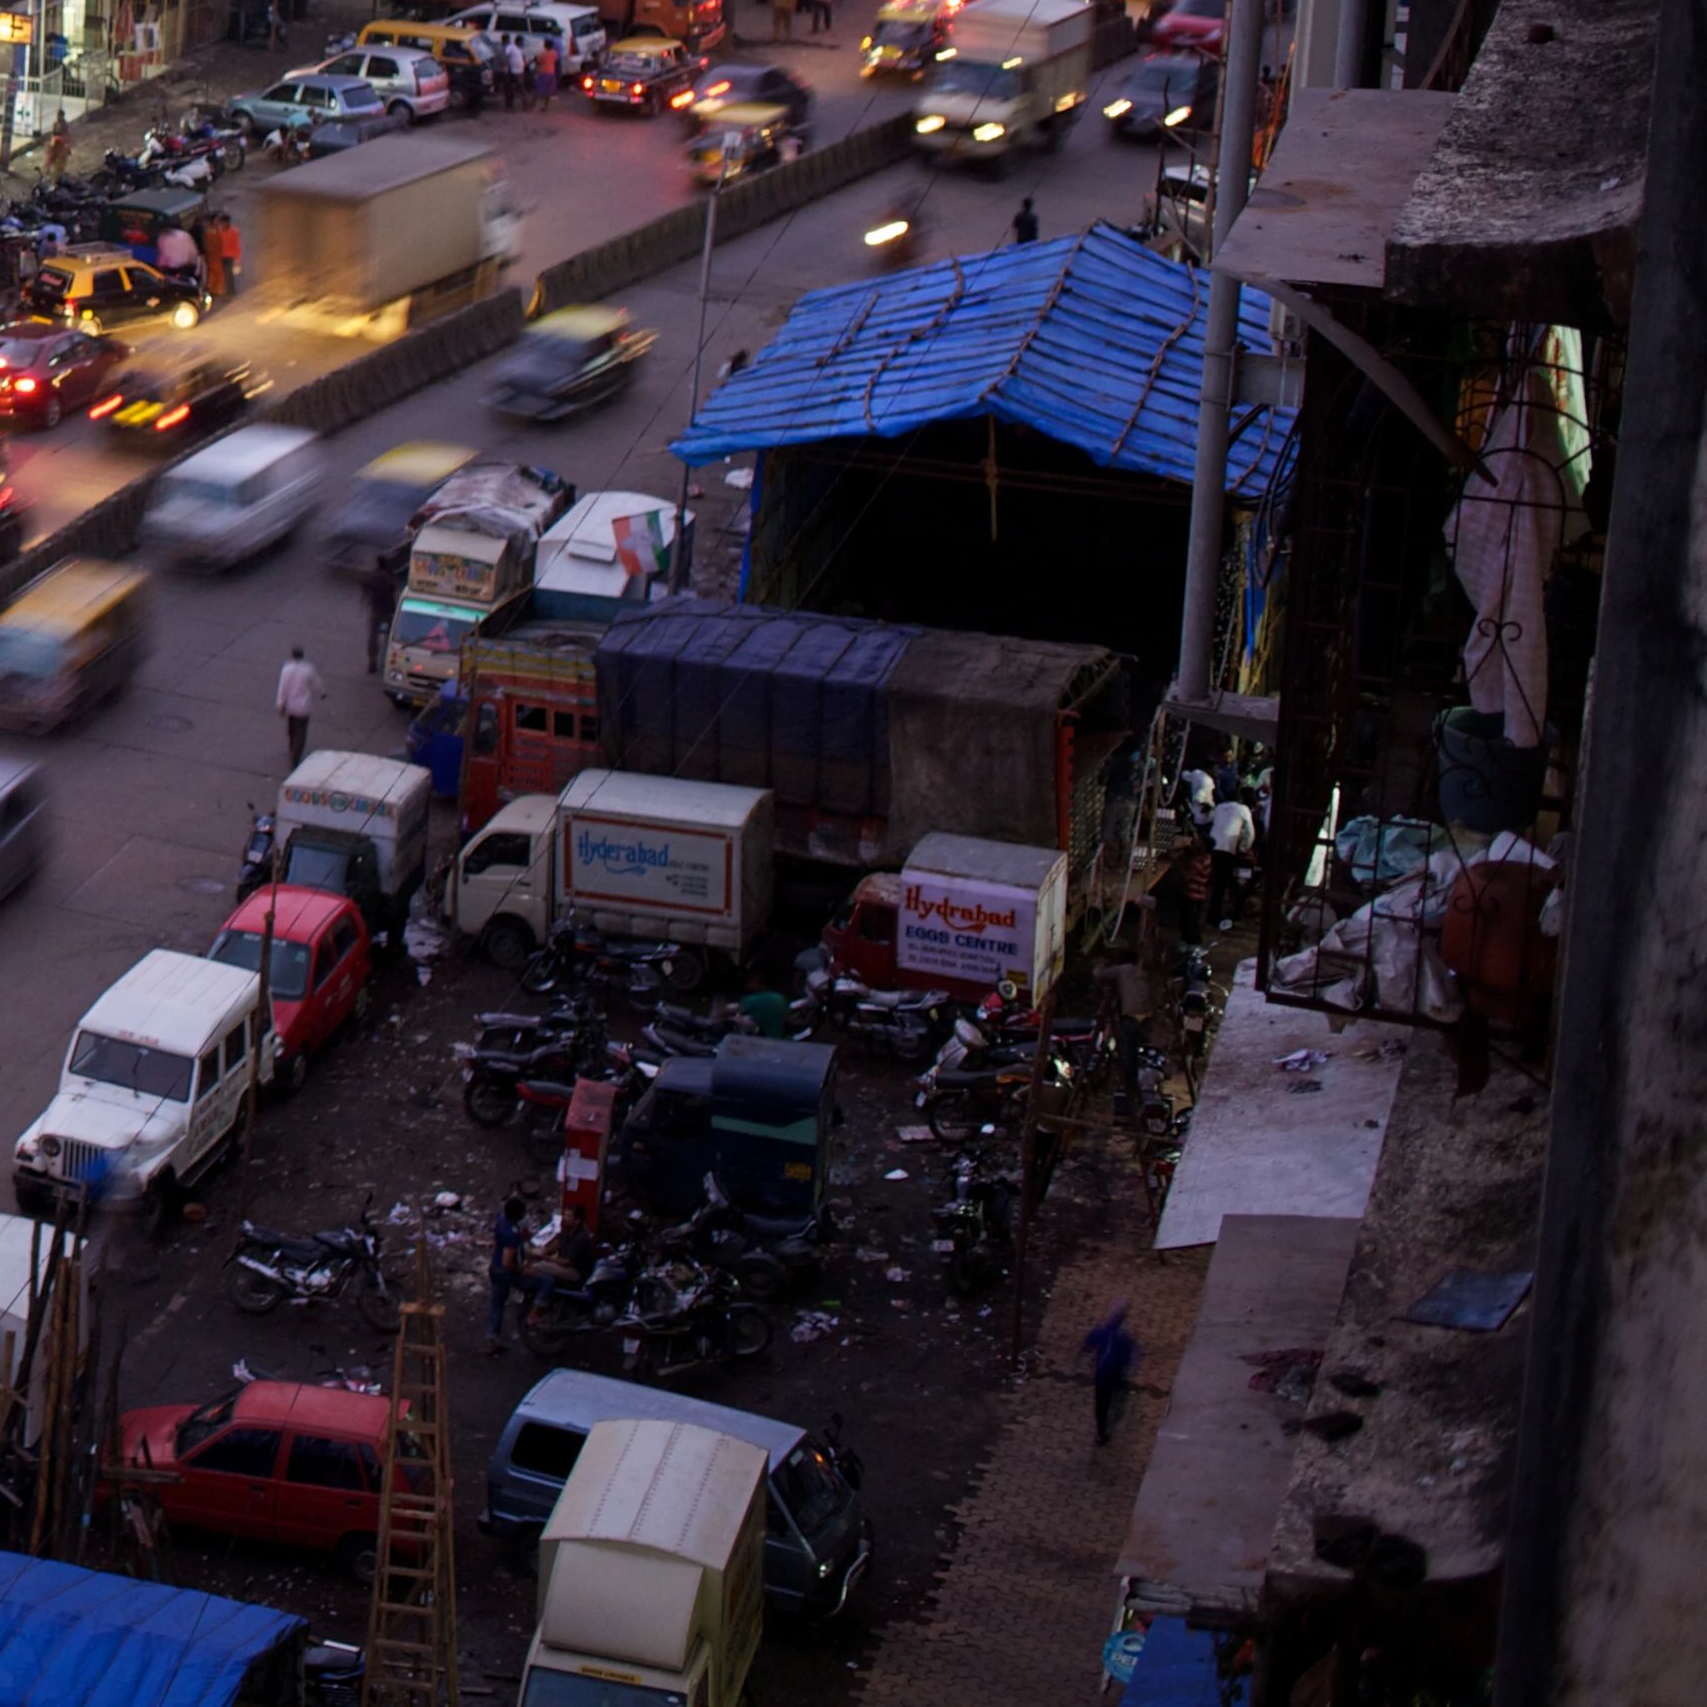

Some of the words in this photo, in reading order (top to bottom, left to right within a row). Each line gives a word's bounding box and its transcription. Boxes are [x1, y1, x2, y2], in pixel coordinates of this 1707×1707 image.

[579, 831, 669, 870] Hyderabad
[905, 885, 1016, 928] Hydrabad
[955, 934, 1017, 956] CENTRE
